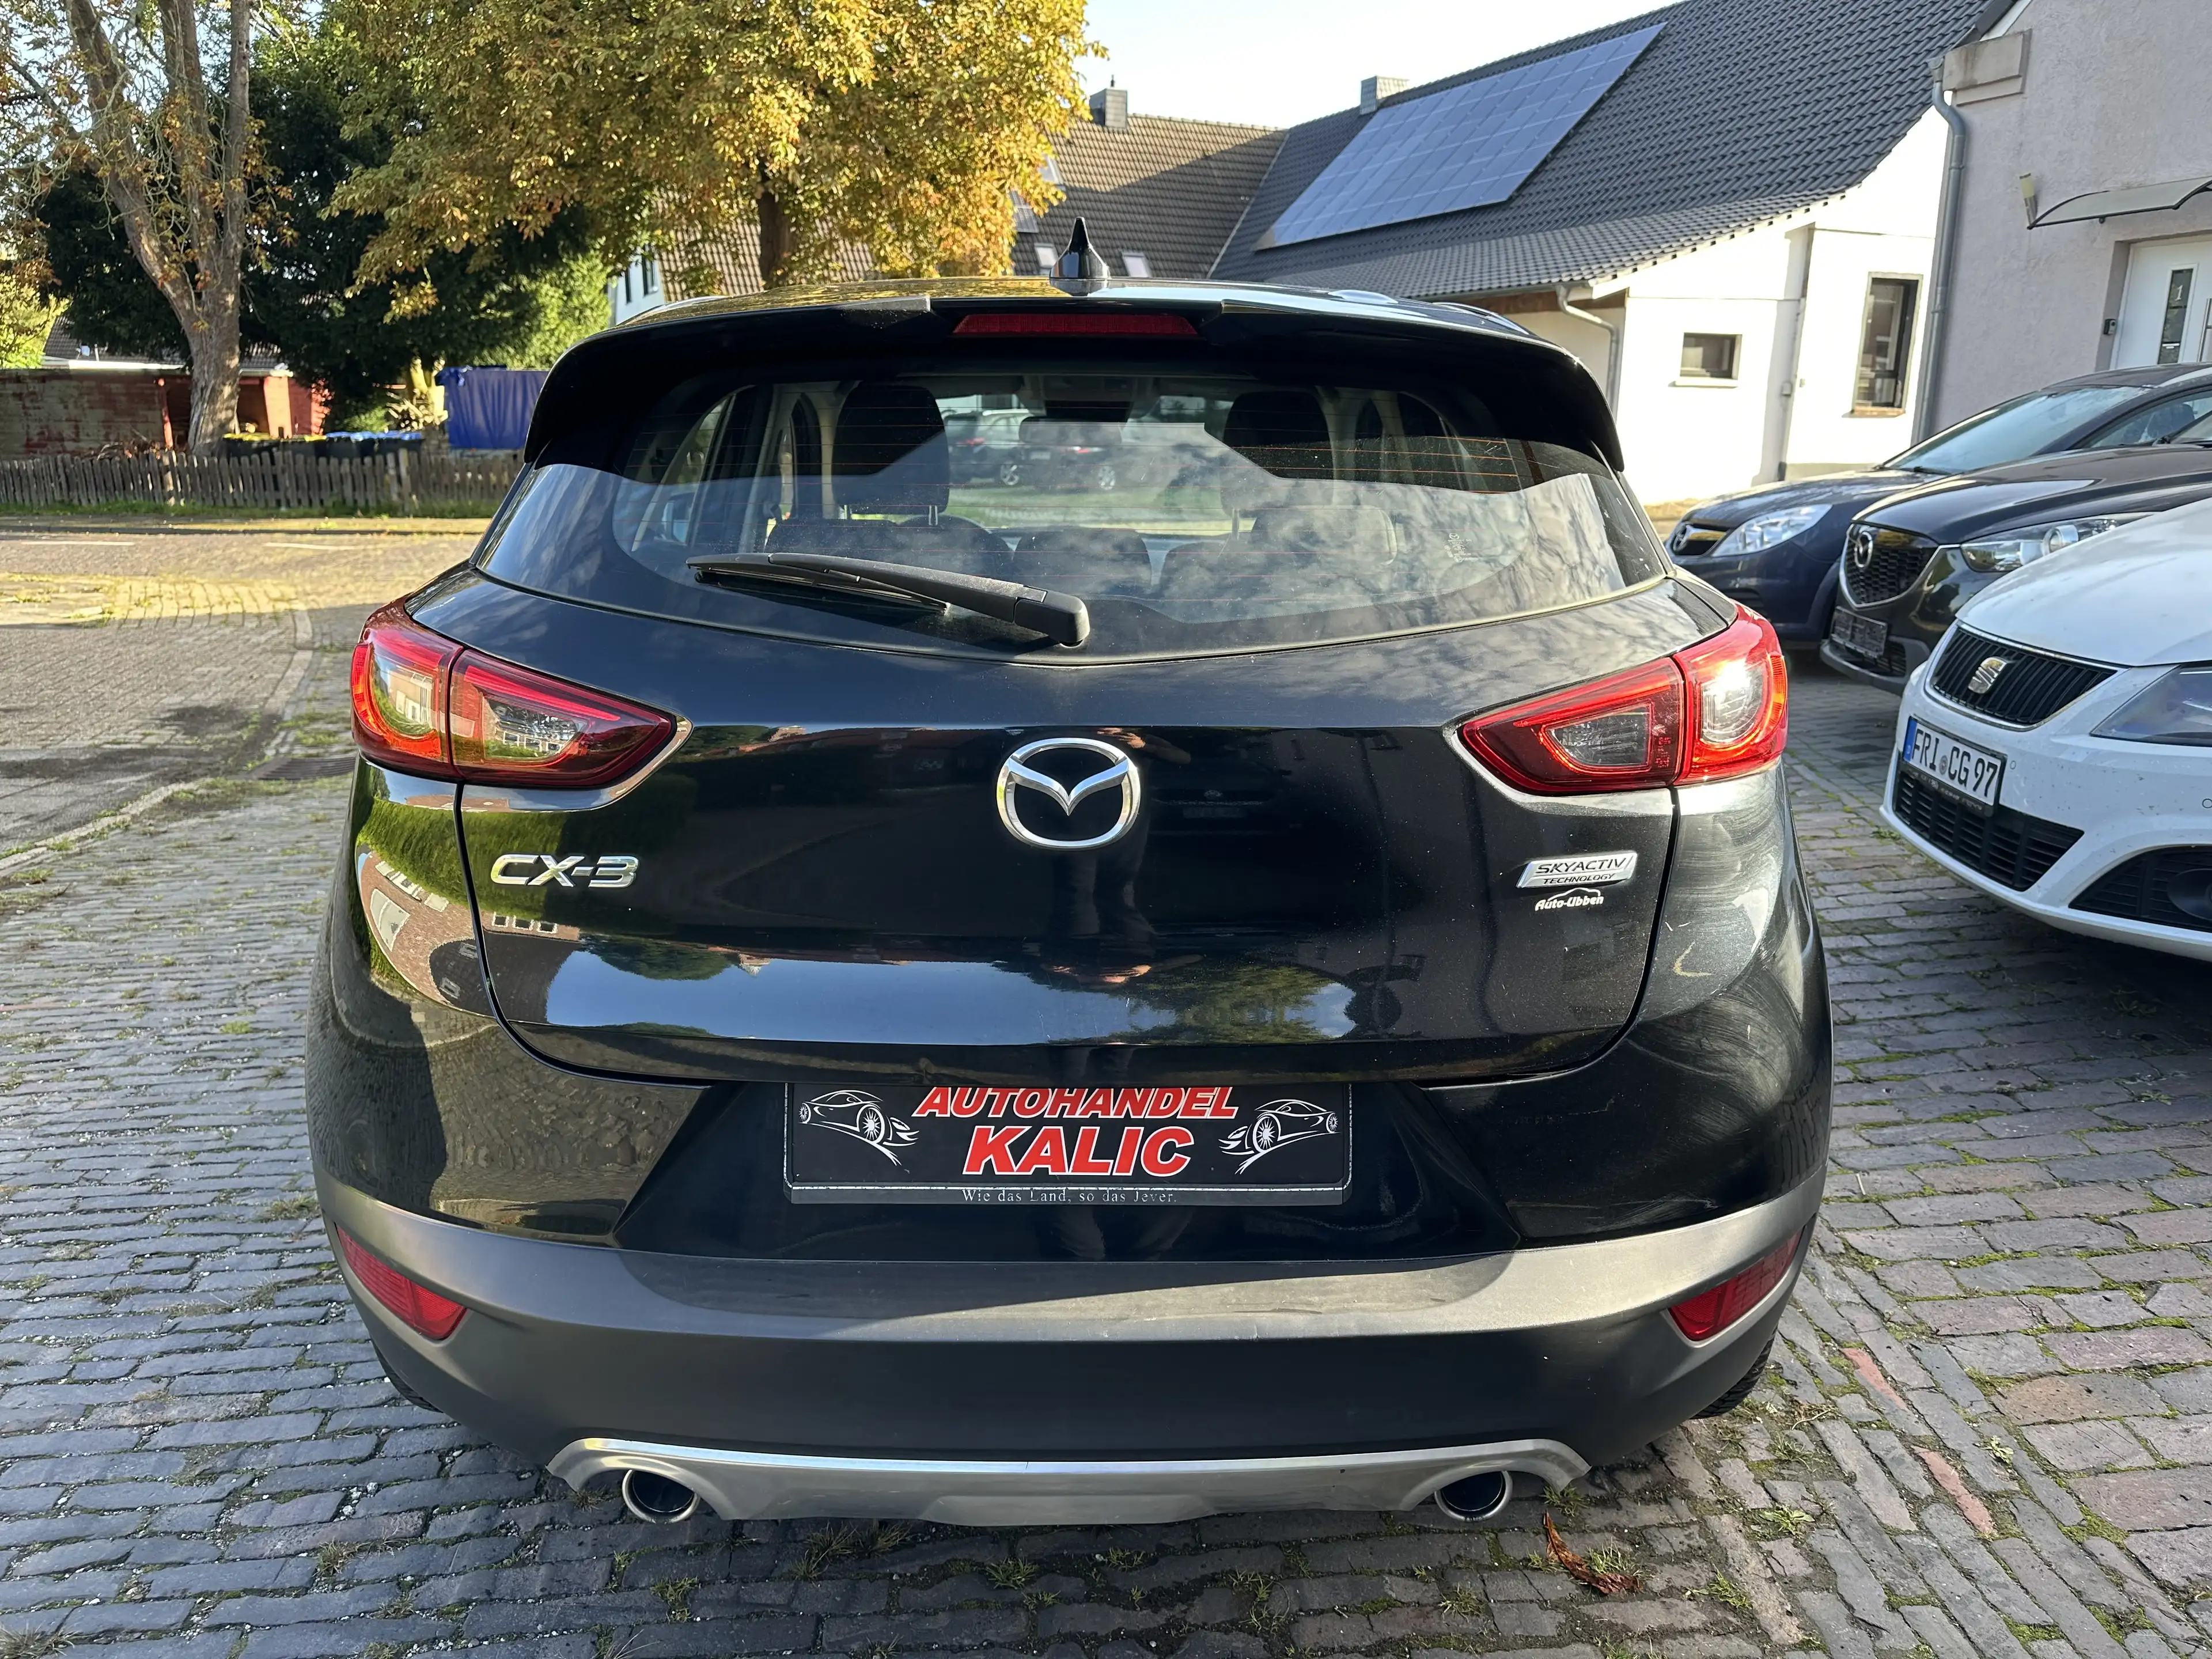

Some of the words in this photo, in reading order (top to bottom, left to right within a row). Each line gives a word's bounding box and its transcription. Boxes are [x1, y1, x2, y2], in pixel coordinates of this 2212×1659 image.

[2175, 285, 2183, 301] 1
[1911, 728, 1940, 771] FRI
[1948, 746, 1971, 789] CG
[1973, 758, 1998, 797] 97
[491, 854, 639, 888] CX-3
[1535, 858, 1626, 873] SKYACTIV
[1543, 873, 1615, 884] TECHNOLOGY
[1535, 895, 1604, 911] Auto-Ubben
[912, 1086, 1239, 1119] AUTOHANDEL
[962, 1125, 1195, 1177] KALIC
[962, 1190, 991, 1202] Wie
[998, 1189, 1022, 1202] das
[1029, 1189, 1072, 1204] Land,
[1079, 1191, 1094, 1202] so
[1102, 1190, 1126, 1202] das
[1134, 1190, 1177, 1203] Jever.
